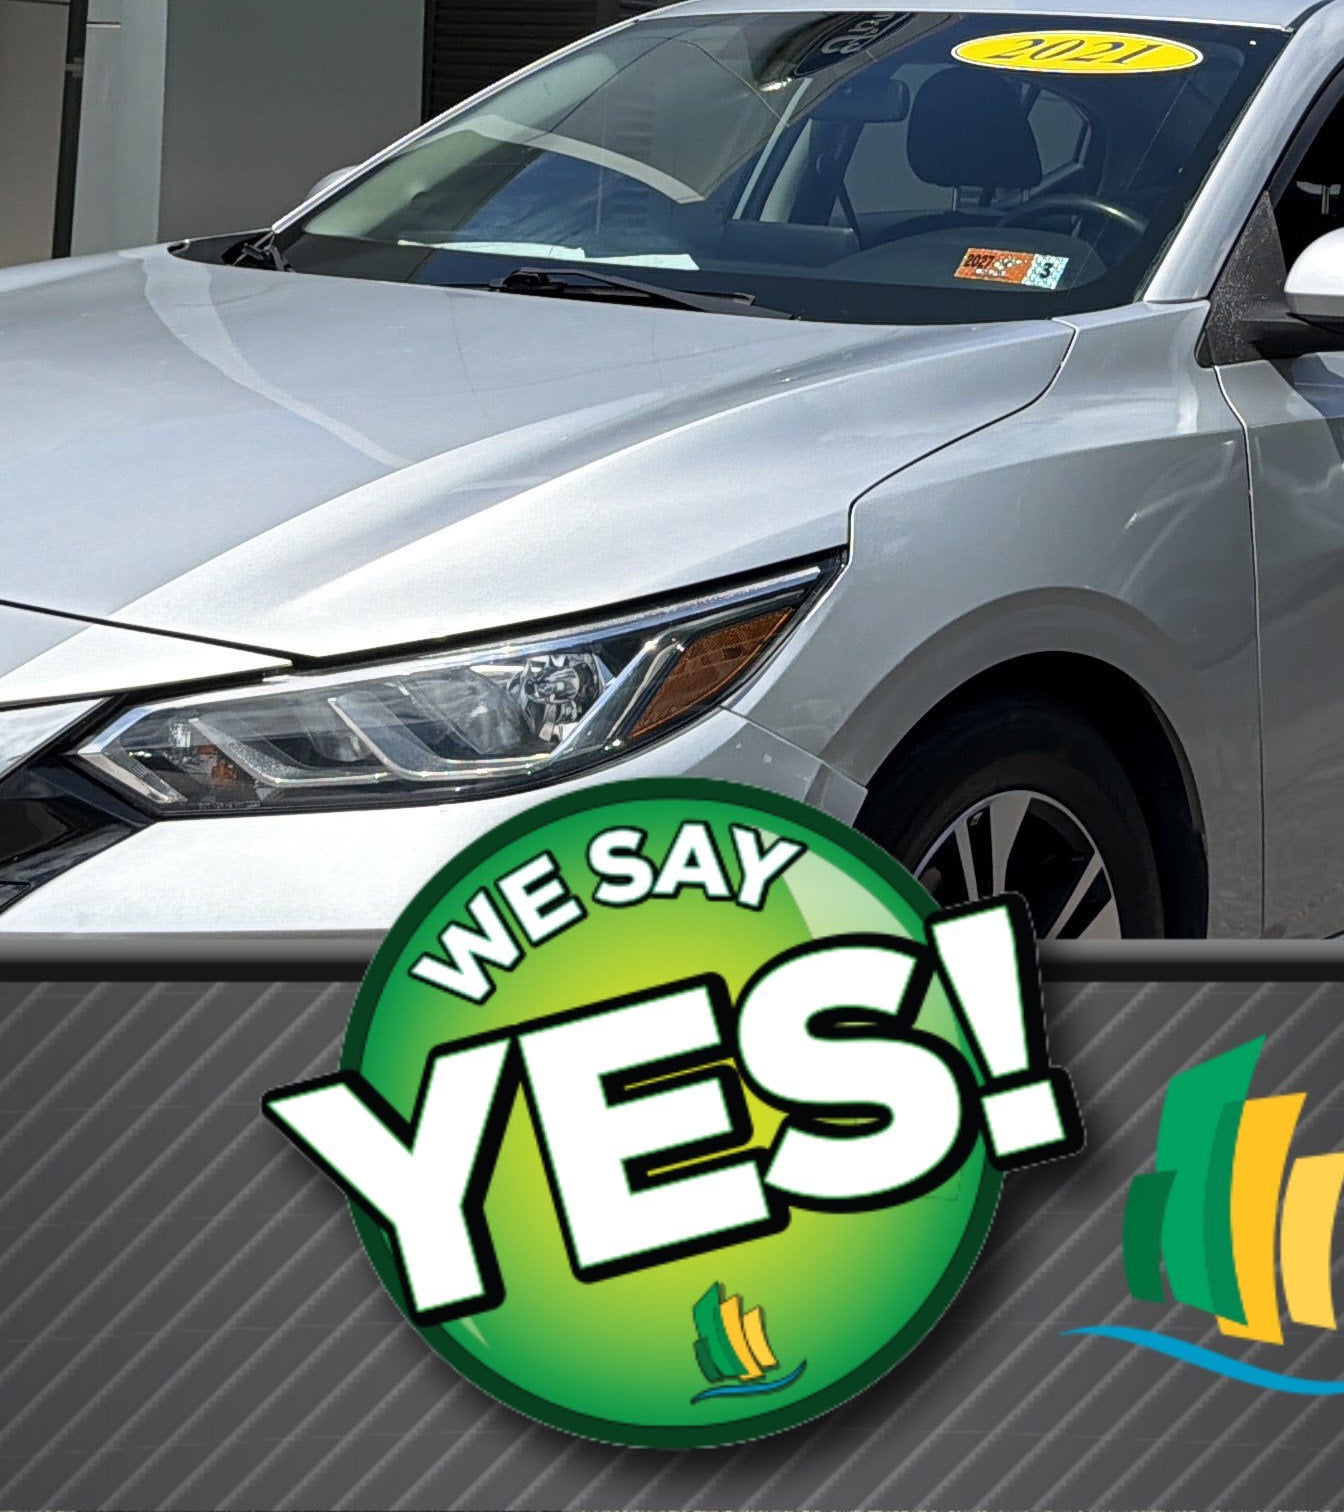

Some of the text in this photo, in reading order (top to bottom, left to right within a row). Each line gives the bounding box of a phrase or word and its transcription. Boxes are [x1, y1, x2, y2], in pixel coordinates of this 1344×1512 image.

[987, 38, 1163, 66] 2021
[964, 254, 995, 268] 2027
[1039, 262, 1054, 278] 3
